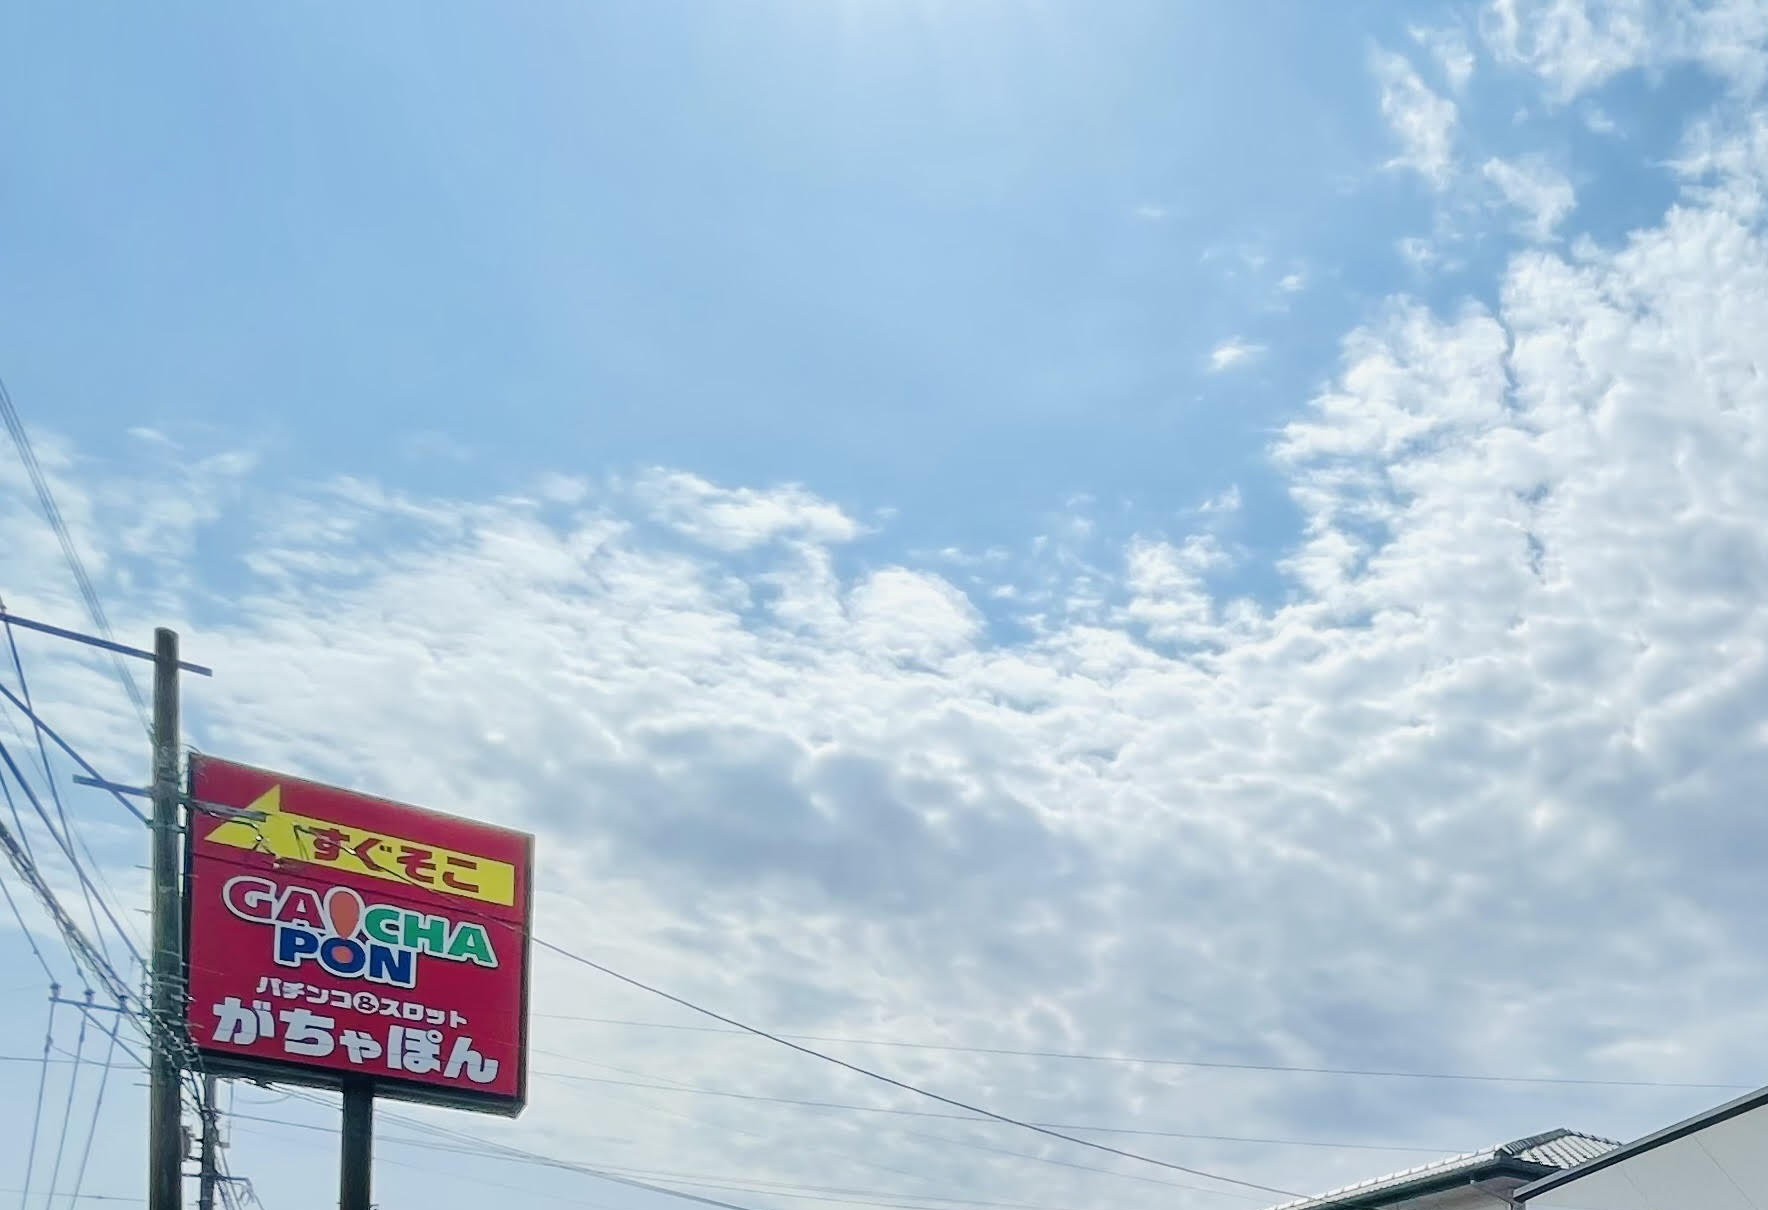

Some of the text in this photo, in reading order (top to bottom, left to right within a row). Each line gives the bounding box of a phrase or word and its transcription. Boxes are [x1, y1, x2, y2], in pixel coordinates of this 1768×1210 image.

[308, 826, 480, 893] すぐそこ
[274, 924, 416, 988] PON
[212, 996, 499, 1084] がちゃぽん
